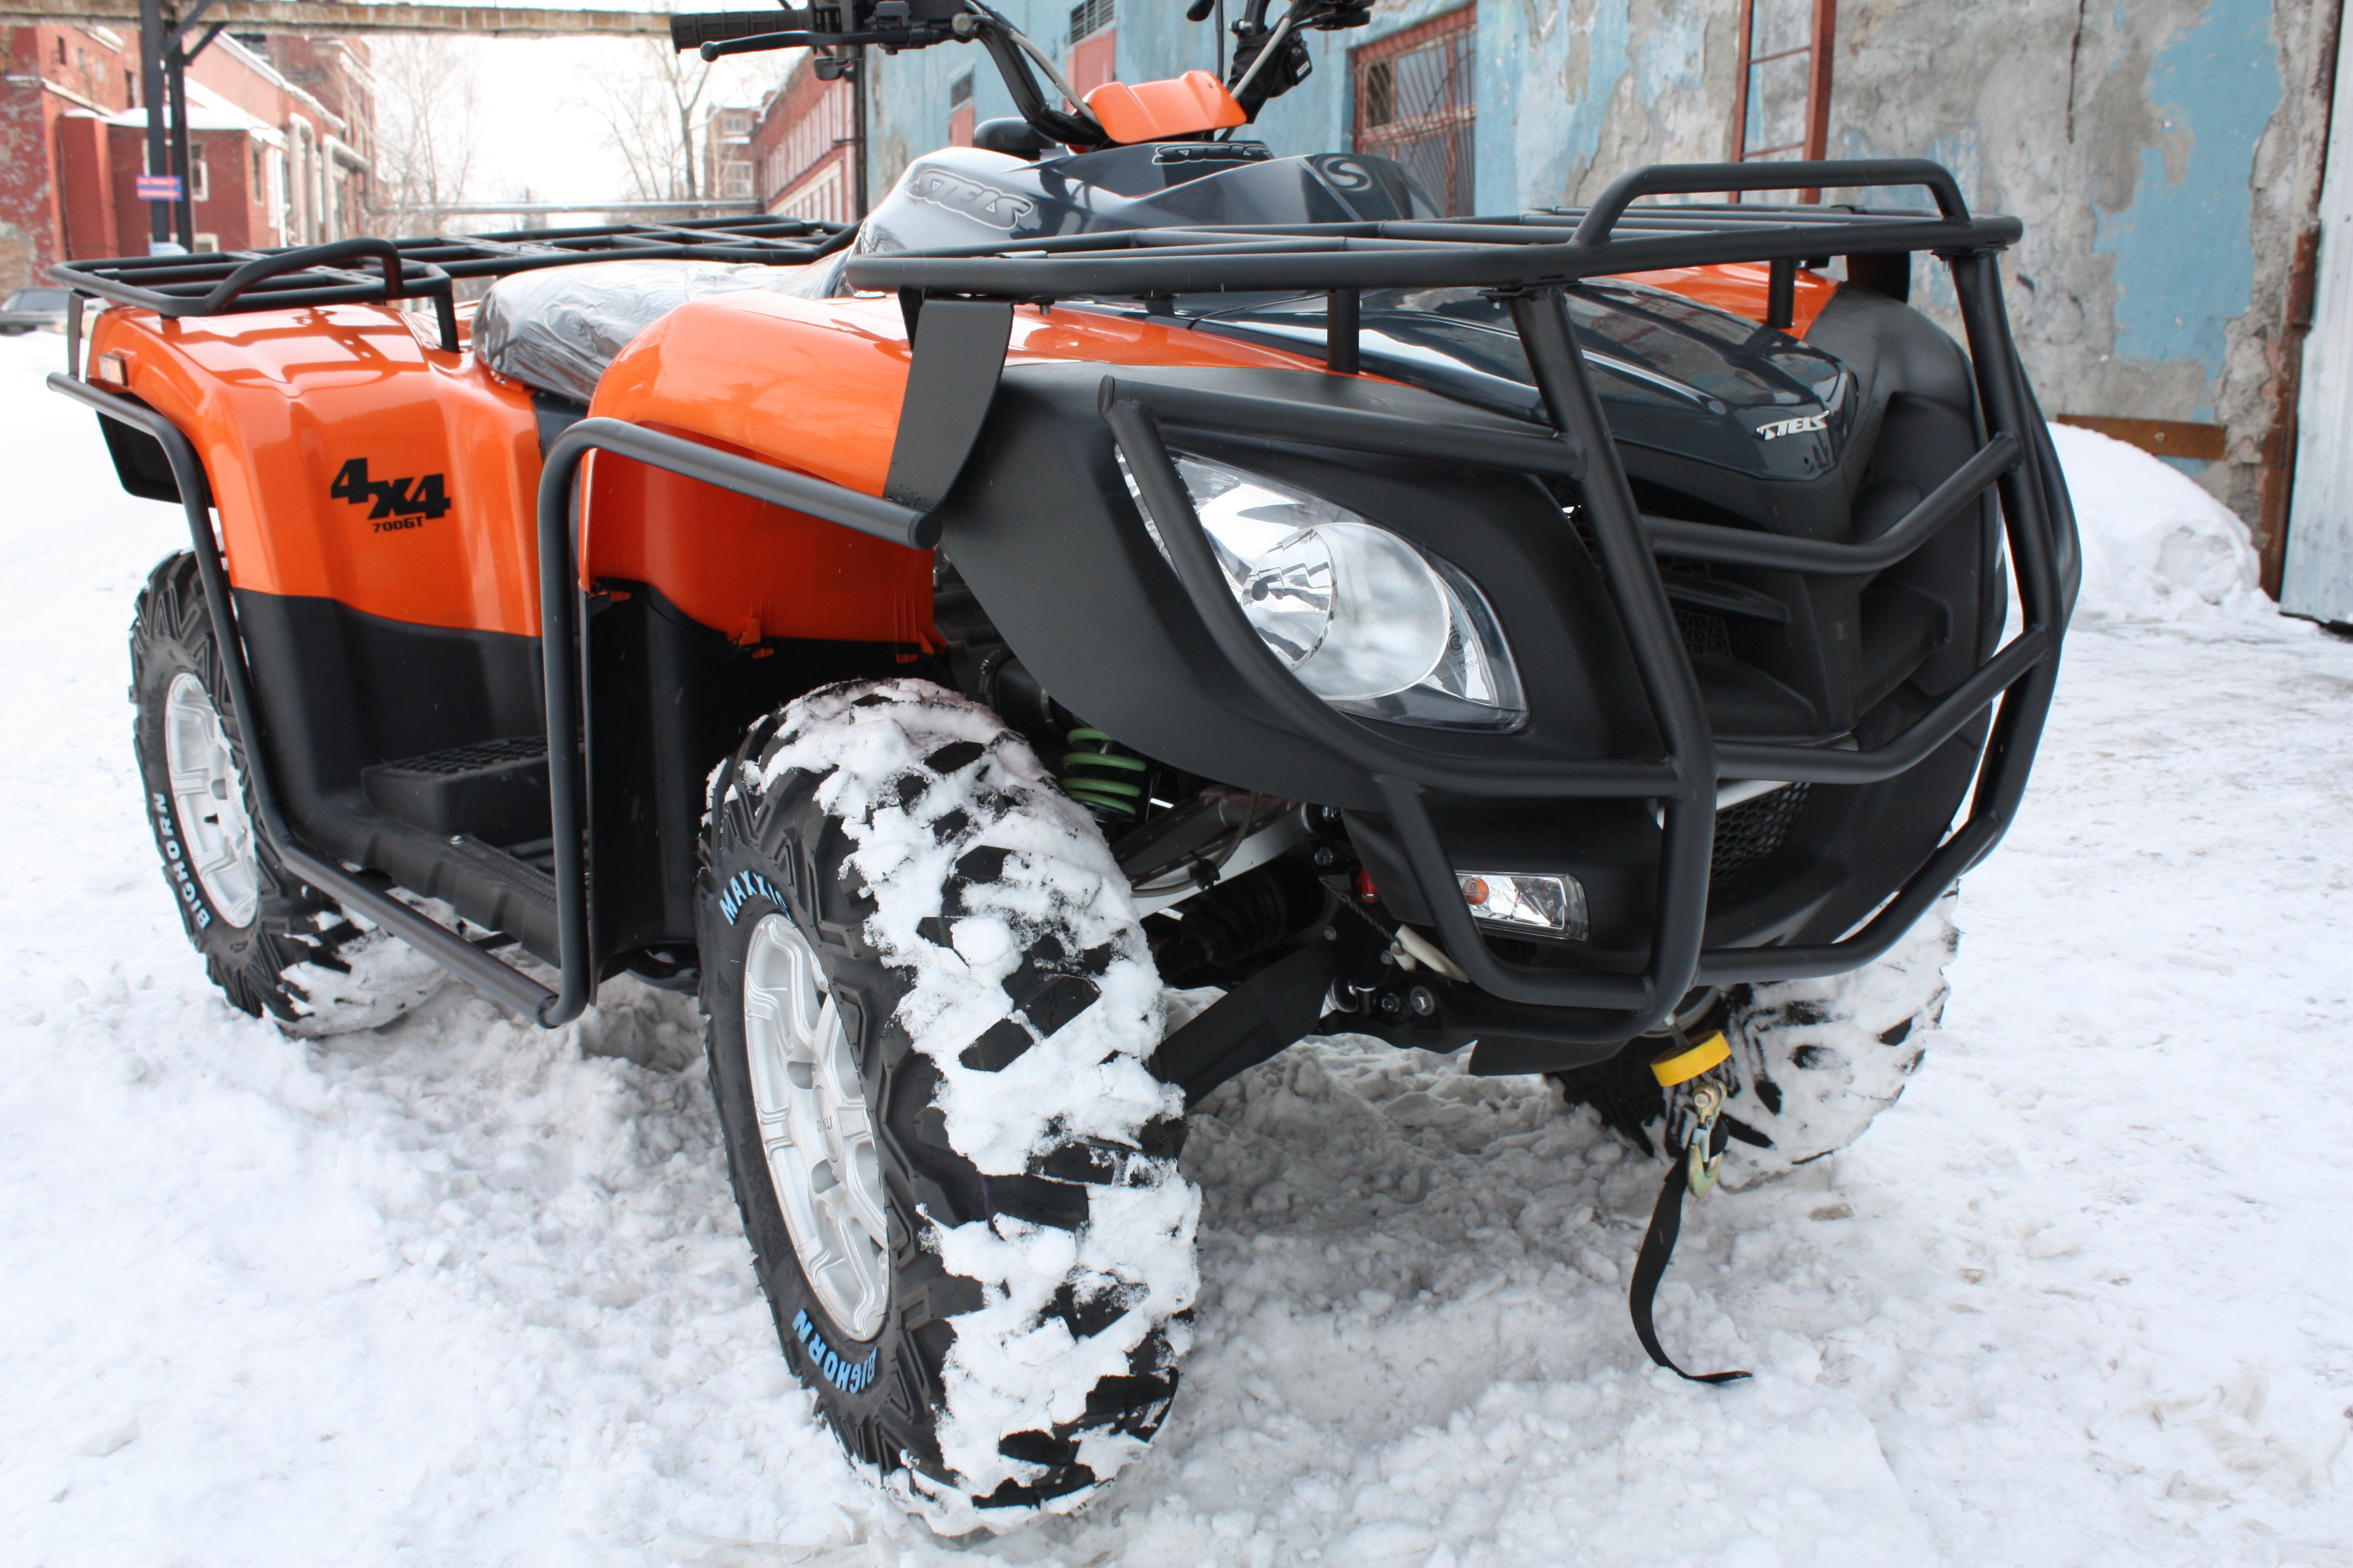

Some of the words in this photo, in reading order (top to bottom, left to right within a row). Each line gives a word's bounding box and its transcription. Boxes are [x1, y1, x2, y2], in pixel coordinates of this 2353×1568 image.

[906, 169, 1033, 230] STELS
[1756, 410, 1829, 441] STELS
[372, 516, 424, 533] 700GT
[153, 792, 211, 929] BIGHORN
[792, 1309, 878, 1394] BIGHORN
